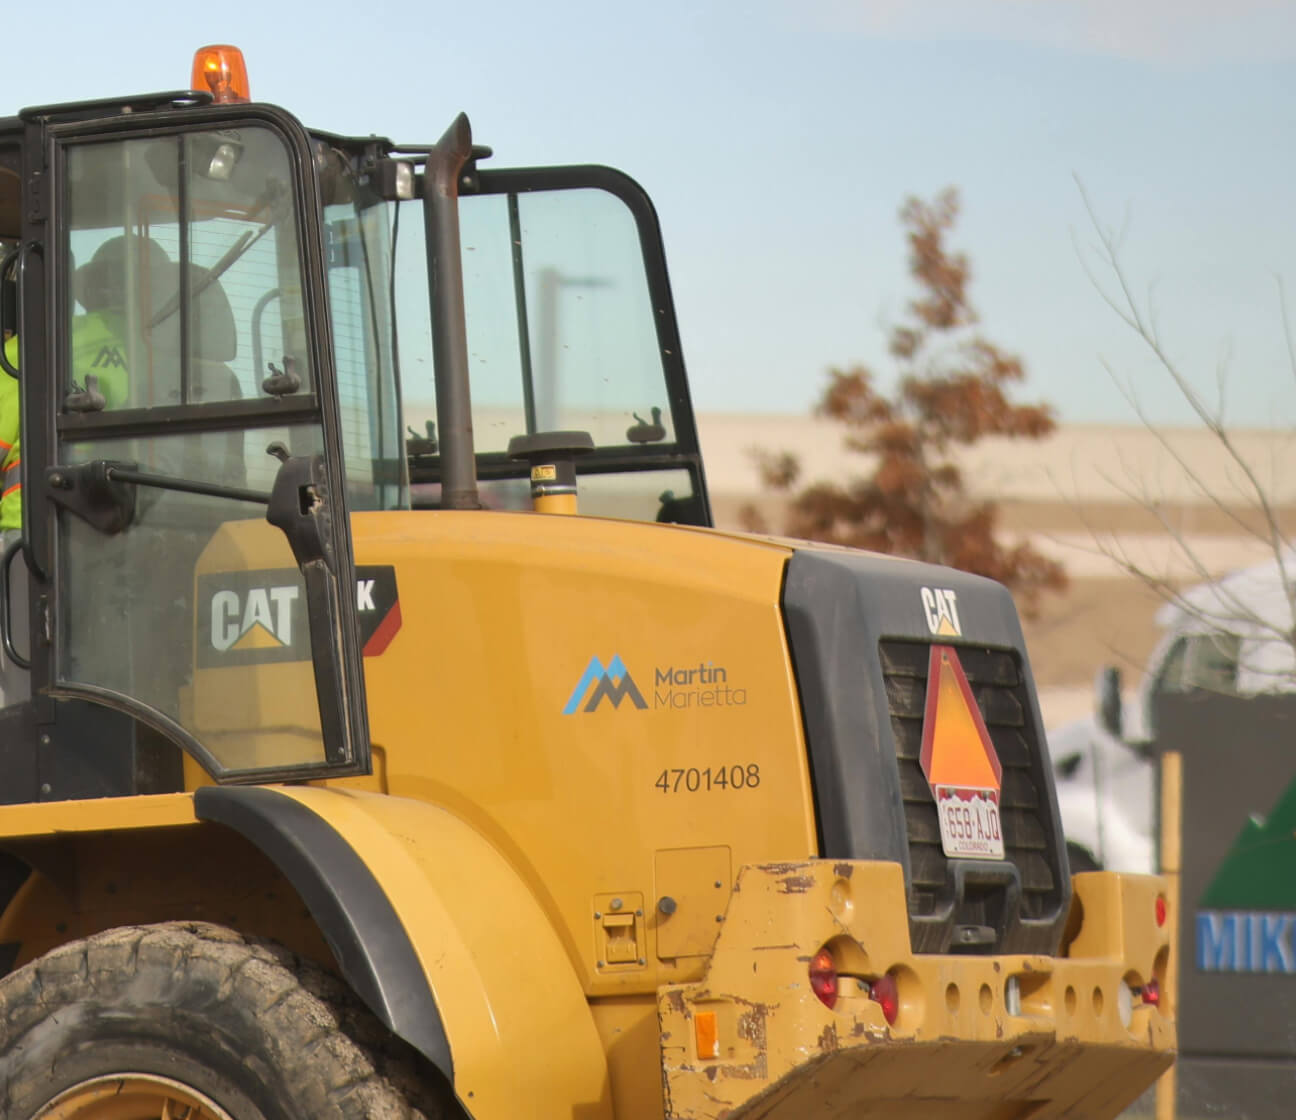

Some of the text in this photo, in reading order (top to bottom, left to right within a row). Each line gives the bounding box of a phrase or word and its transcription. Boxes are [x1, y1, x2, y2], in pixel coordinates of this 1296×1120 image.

[211, 586, 299, 651] CAT
[920, 586, 962, 637] CAT
[655, 661, 728, 687] Martin
[654, 685, 747, 710] Marietta
[655, 763, 760, 794] 4701408
[1197, 911, 1296, 972] MIK
